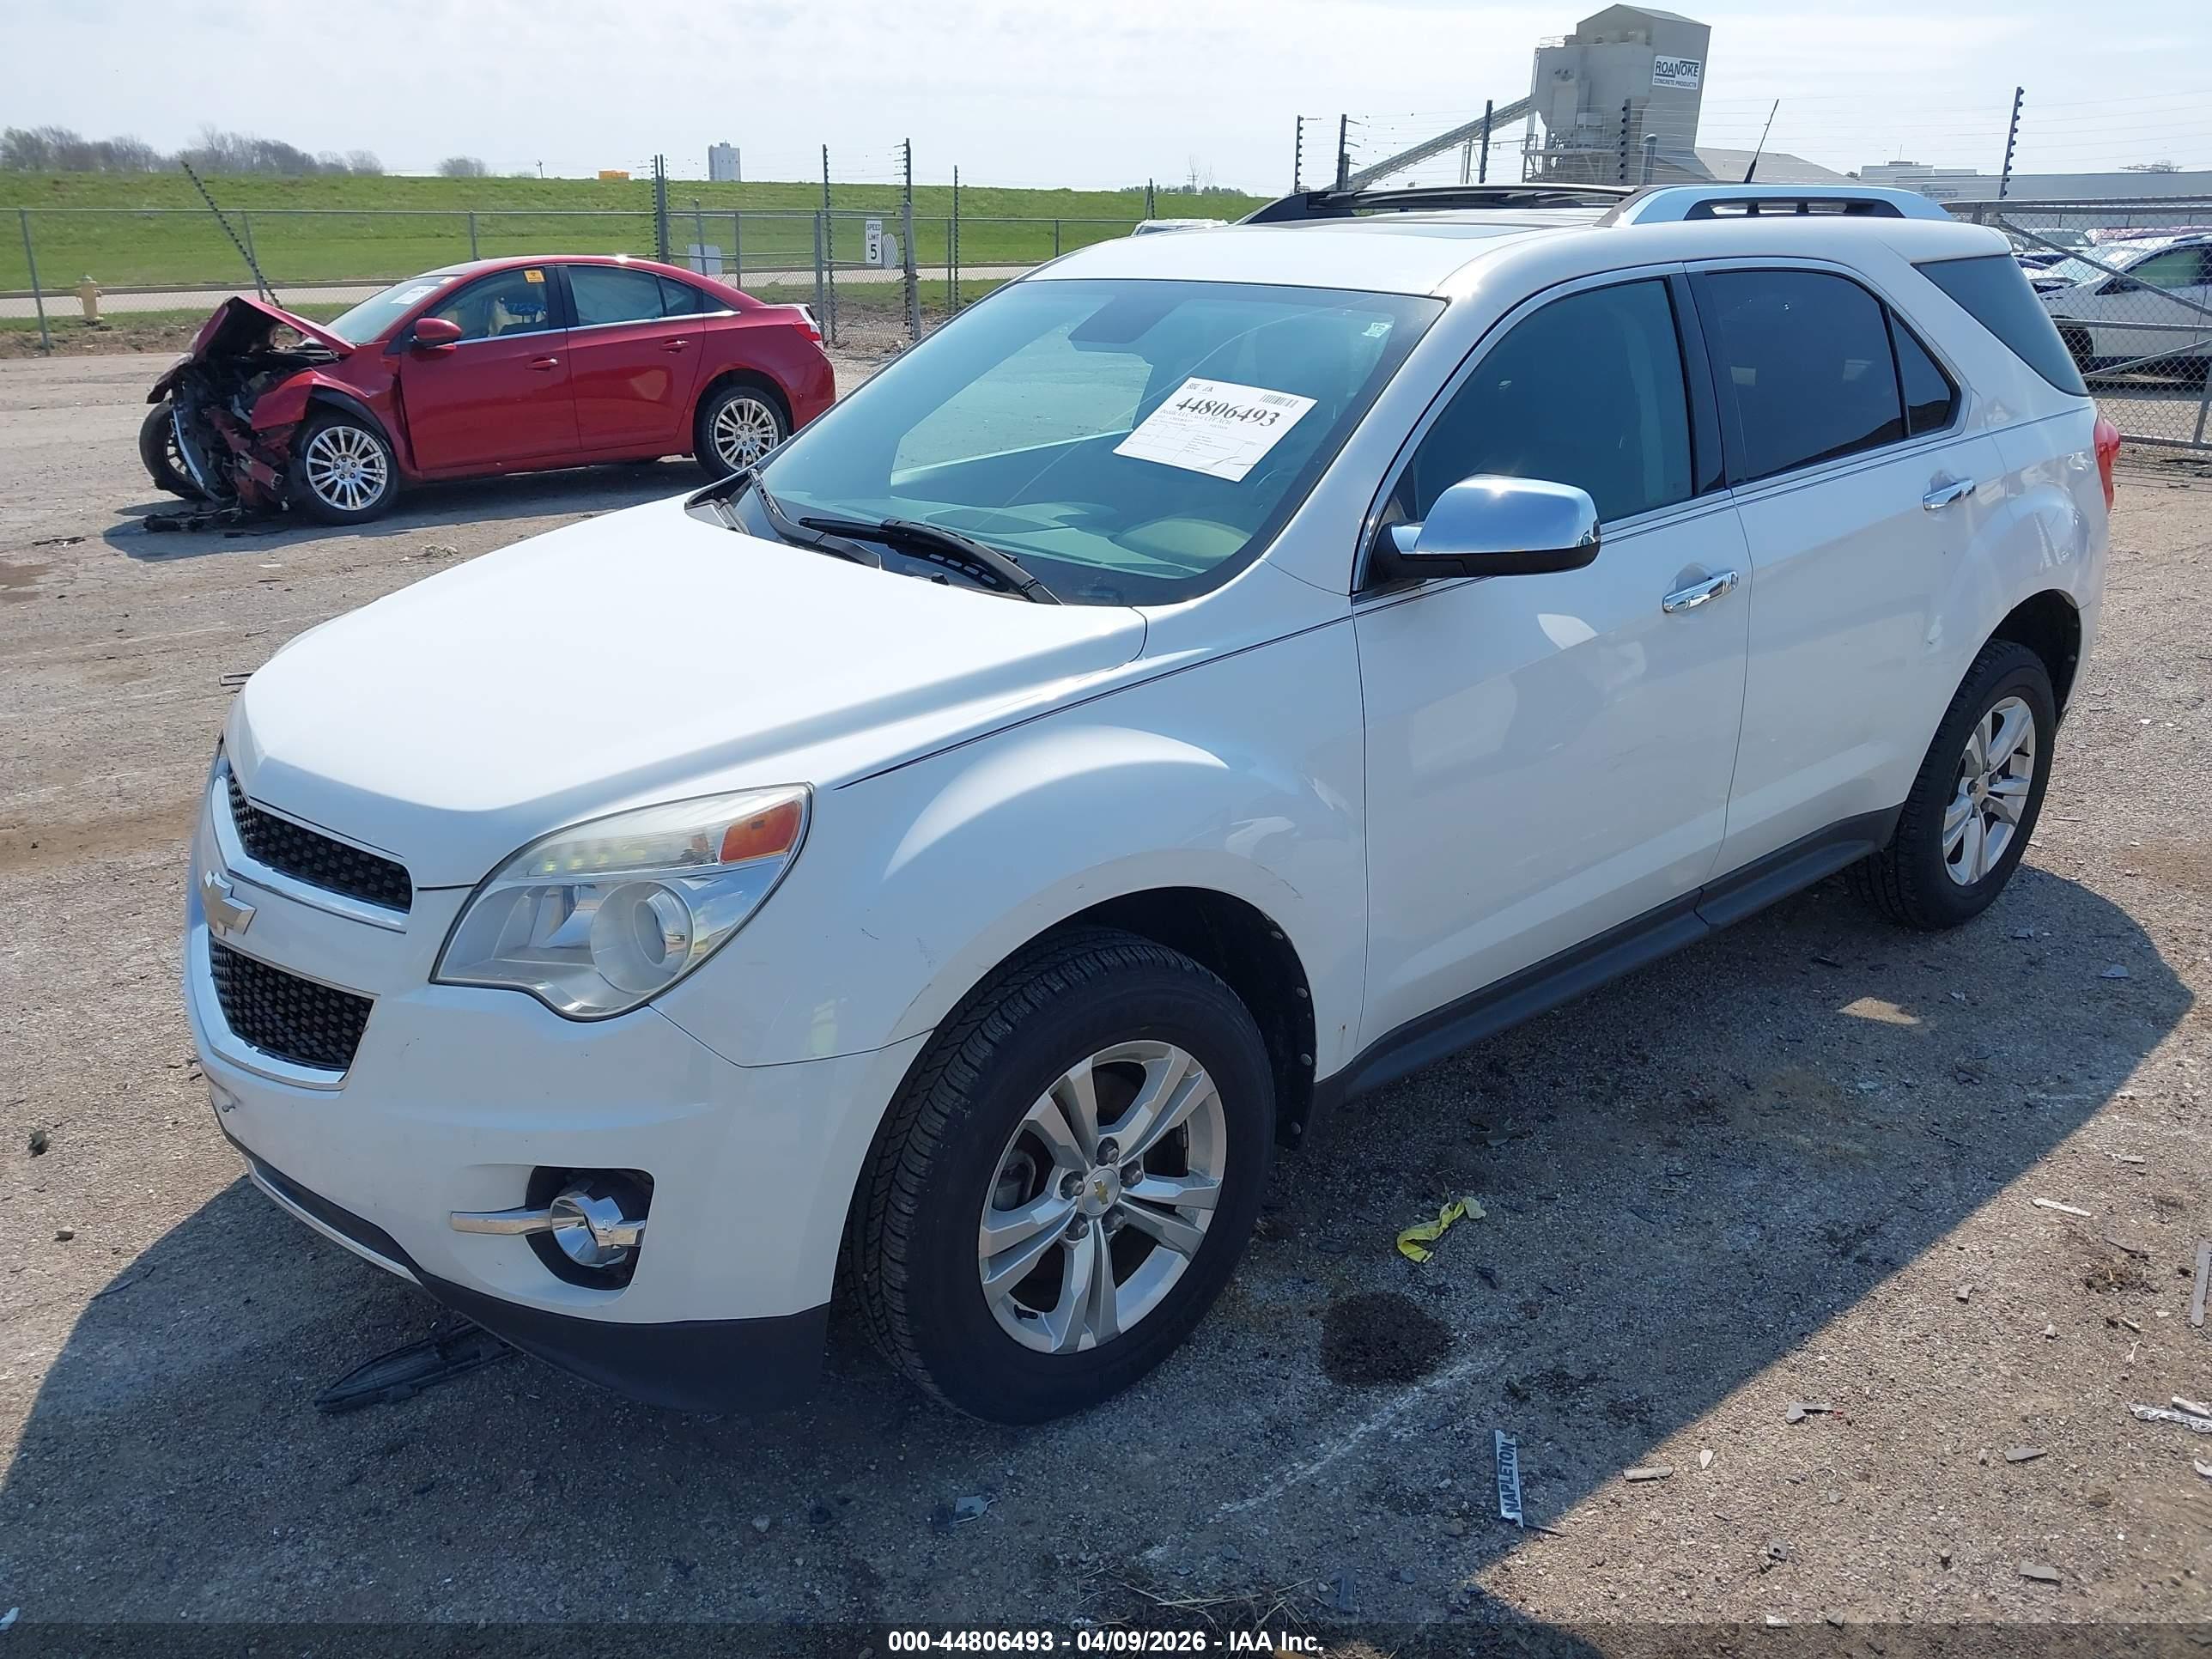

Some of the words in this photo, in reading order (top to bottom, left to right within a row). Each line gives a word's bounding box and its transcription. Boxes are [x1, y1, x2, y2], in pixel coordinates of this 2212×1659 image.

[1656, 61, 1699, 77] ROANOKE
[871, 243, 878, 260] 5
[1176, 397, 1280, 427] 44806493
[1498, 1442, 1522, 1513] NAPLETON
